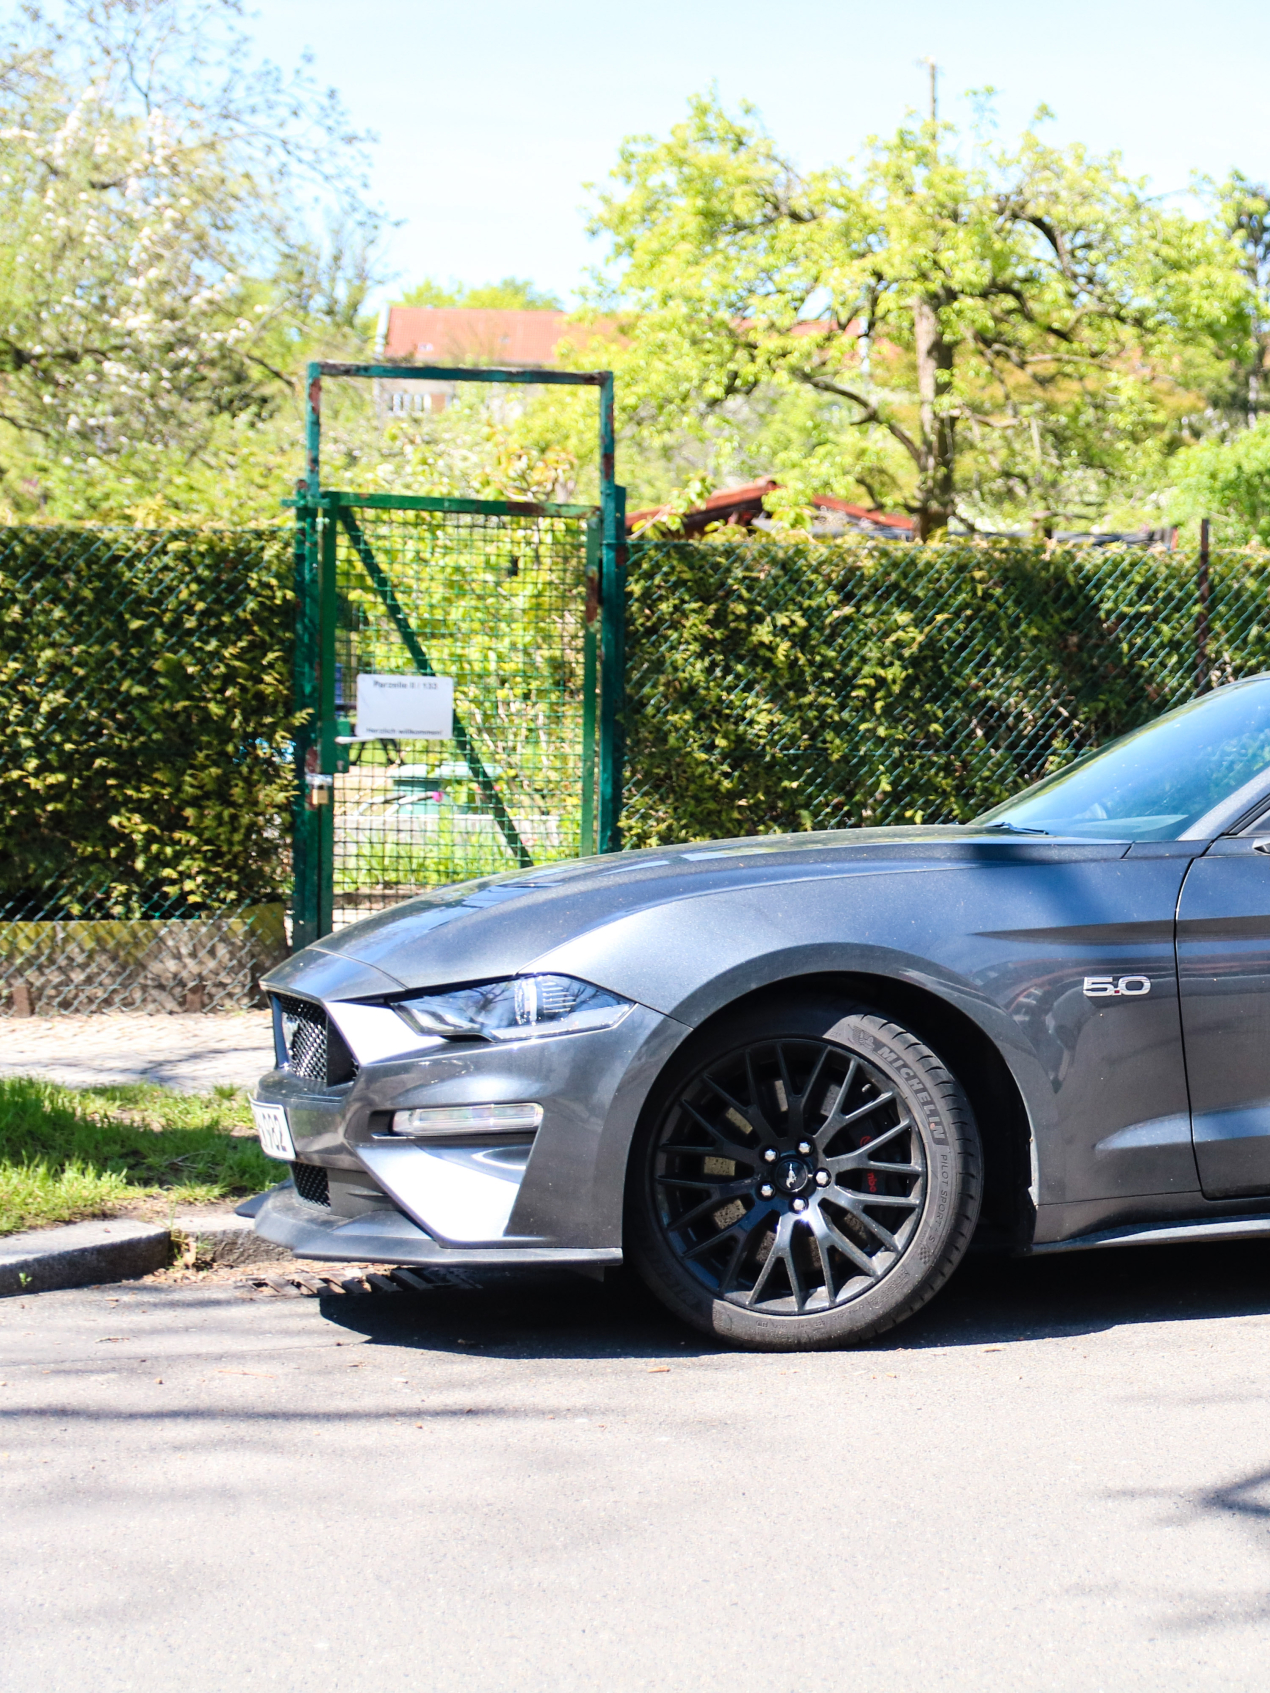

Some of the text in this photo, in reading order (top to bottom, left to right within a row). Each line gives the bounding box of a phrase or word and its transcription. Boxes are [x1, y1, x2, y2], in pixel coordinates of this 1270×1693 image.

[1083, 975, 1151, 997] 5.0
[877, 1046, 946, 1139] MICHELIN
[940, 1154, 949, 1187] PILOT
[935, 1189, 948, 1227] SPORT
